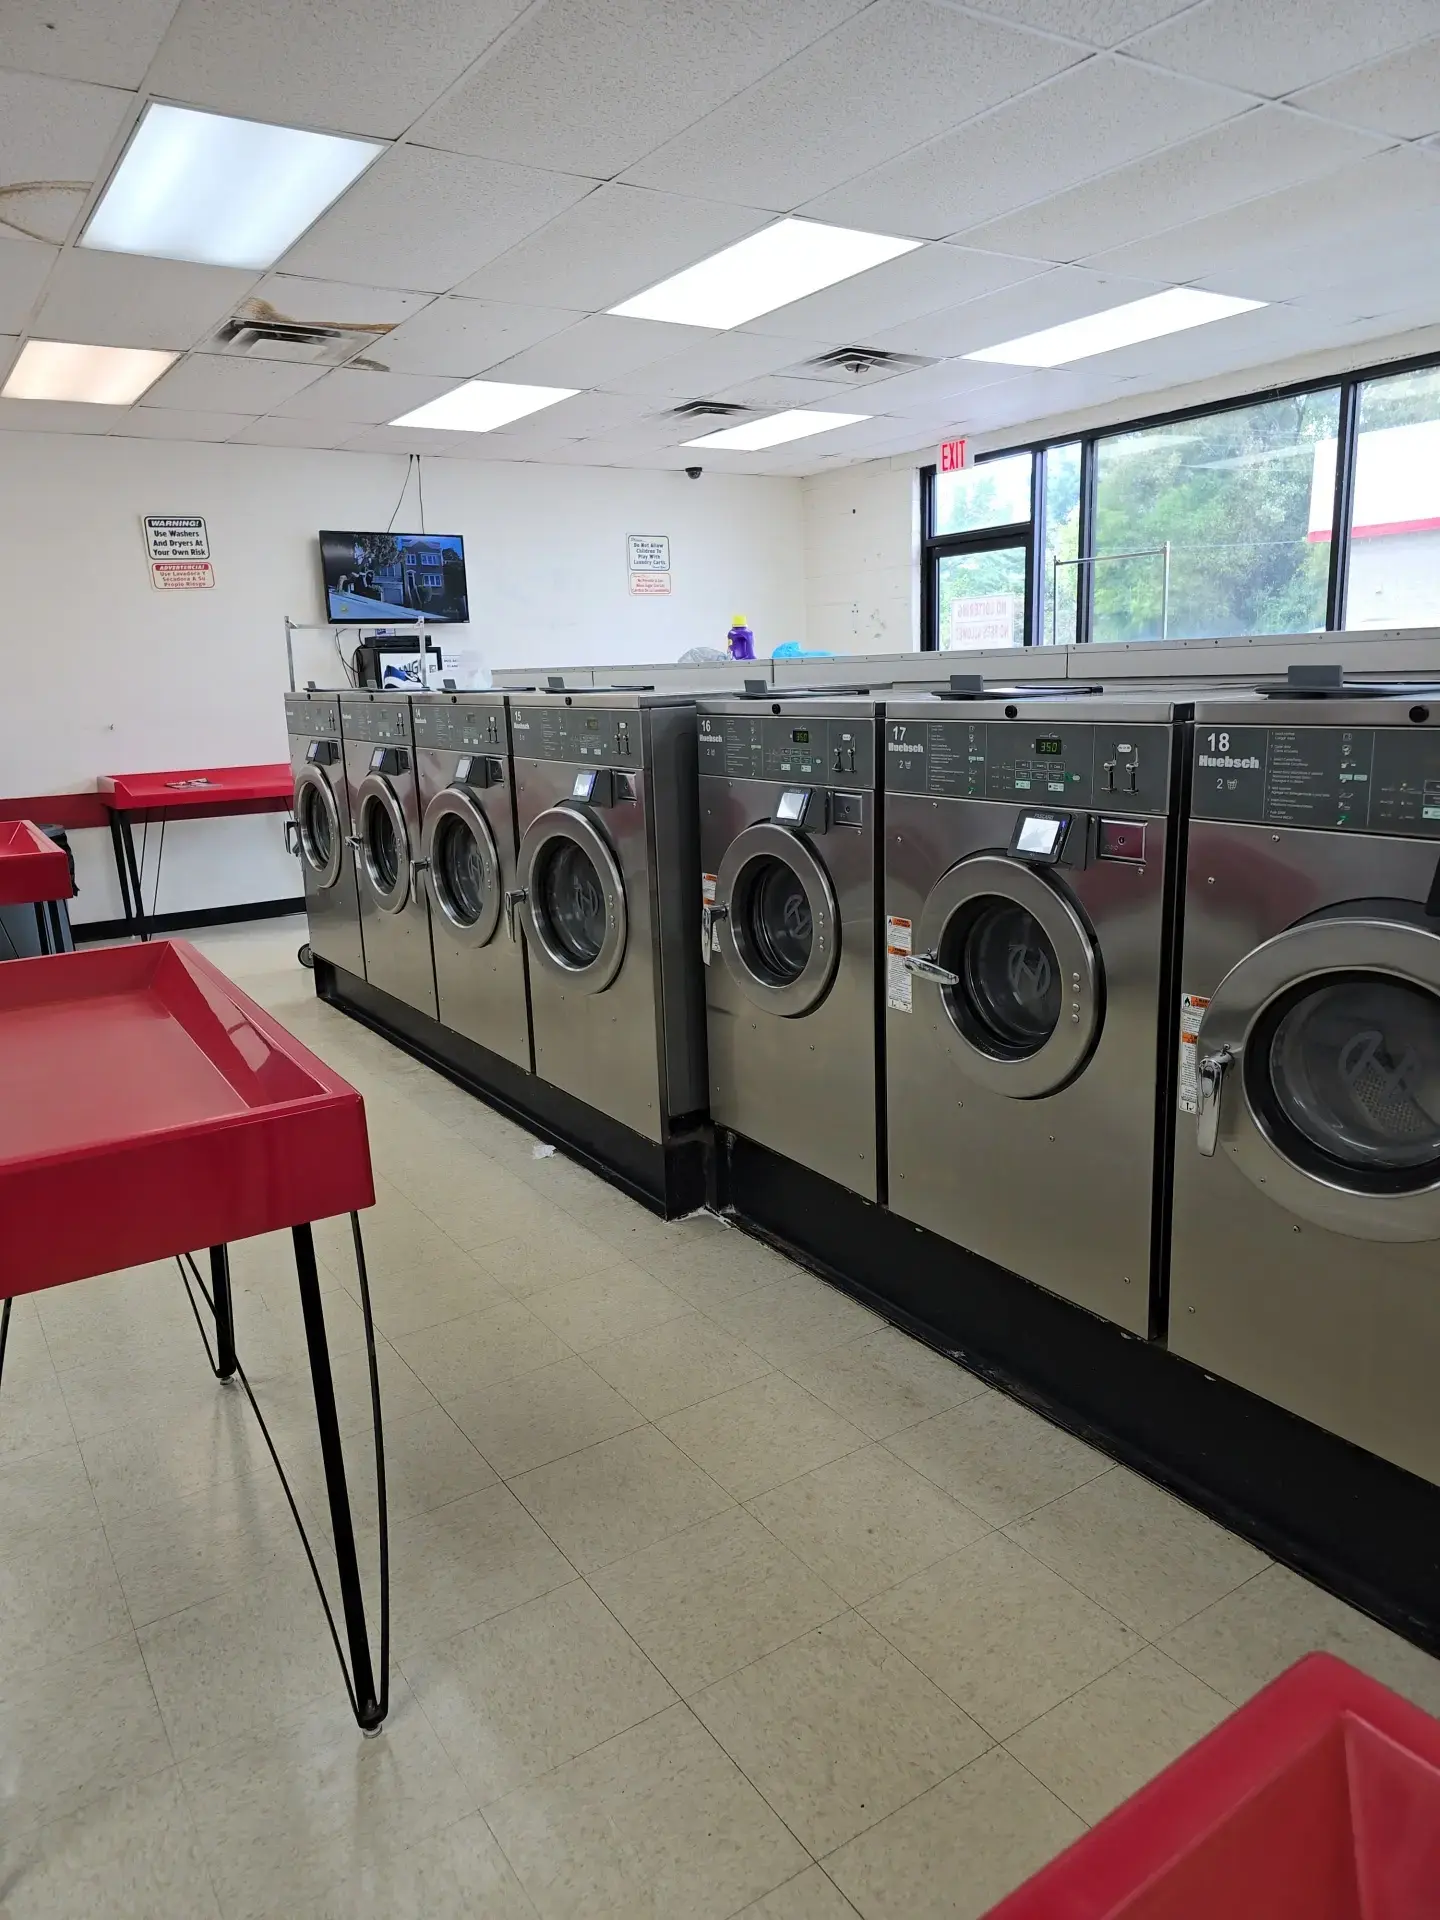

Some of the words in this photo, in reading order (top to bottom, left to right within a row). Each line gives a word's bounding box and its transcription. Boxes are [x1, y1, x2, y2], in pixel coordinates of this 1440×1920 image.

[942, 440, 965, 471] EXIT
[514, 711, 521, 721] 15
[702, 720, 711, 732] 16
[893, 726, 906, 740] 17
[1041, 742, 1057, 752] 350
[1208, 733, 1230, 751] 18
[899, 760, 903, 768] 2
[1199, 755, 1260, 769] Huebsch
[1216, 778, 1223, 789] 2
